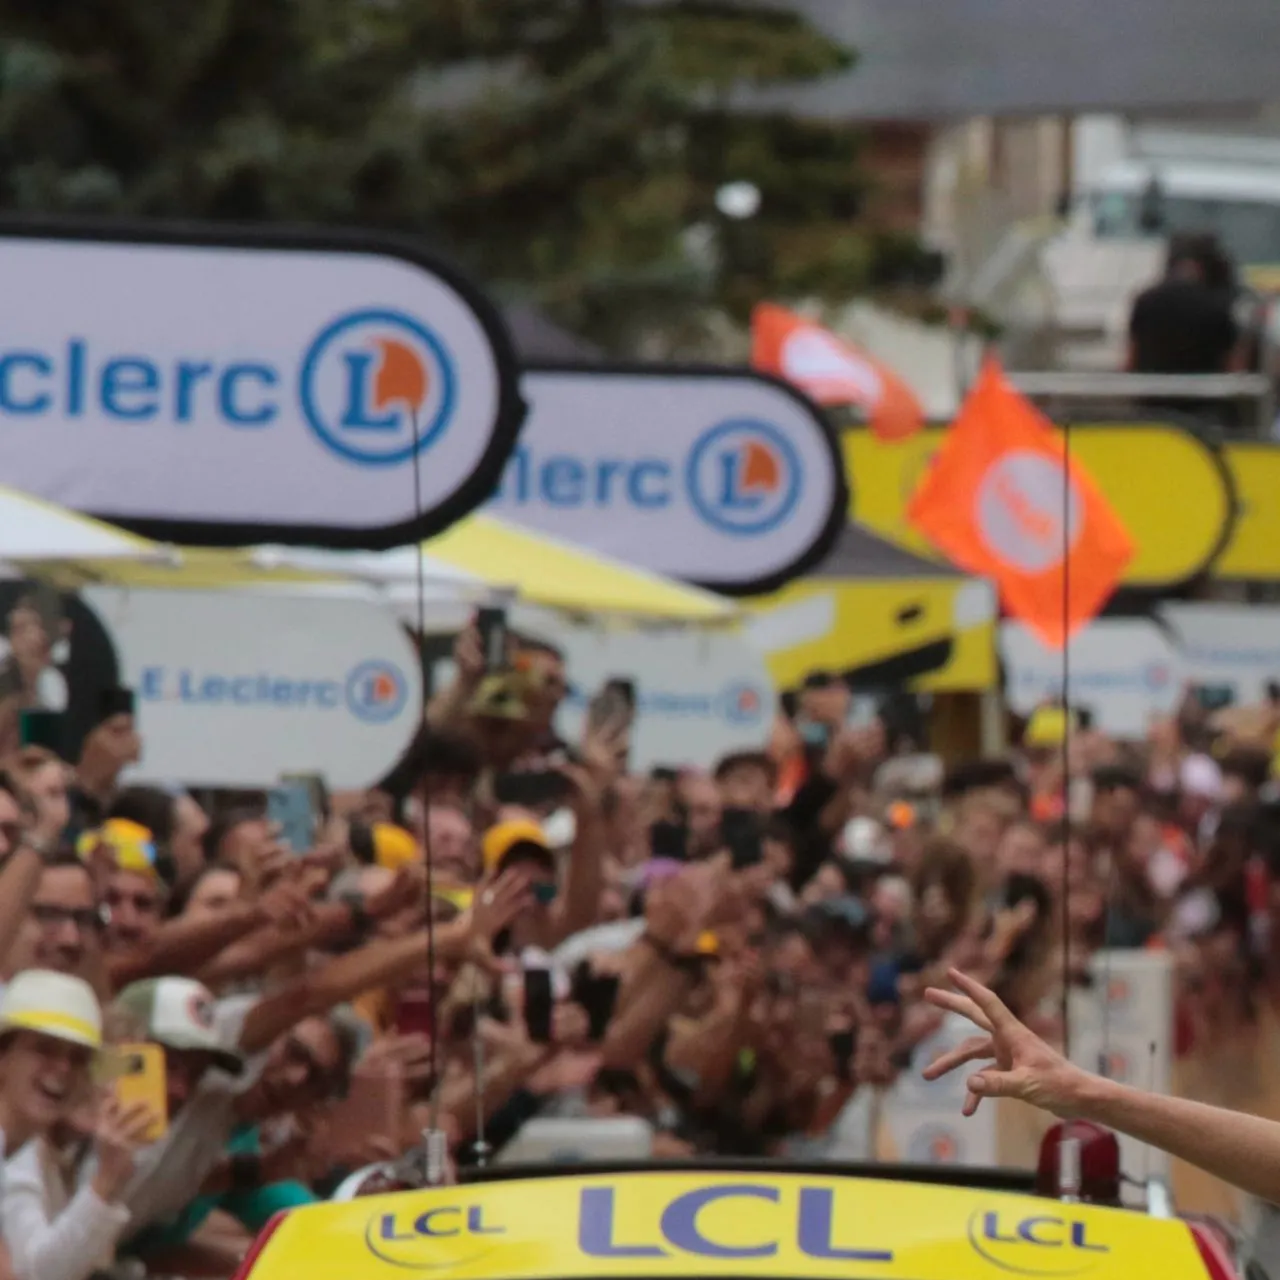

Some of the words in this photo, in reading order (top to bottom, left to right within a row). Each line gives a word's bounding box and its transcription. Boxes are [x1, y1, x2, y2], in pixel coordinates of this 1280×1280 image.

[380, 1206, 507, 1240] LCL
[577, 1185, 894, 1262] LCL
[982, 1211, 1110, 1252] LCL
